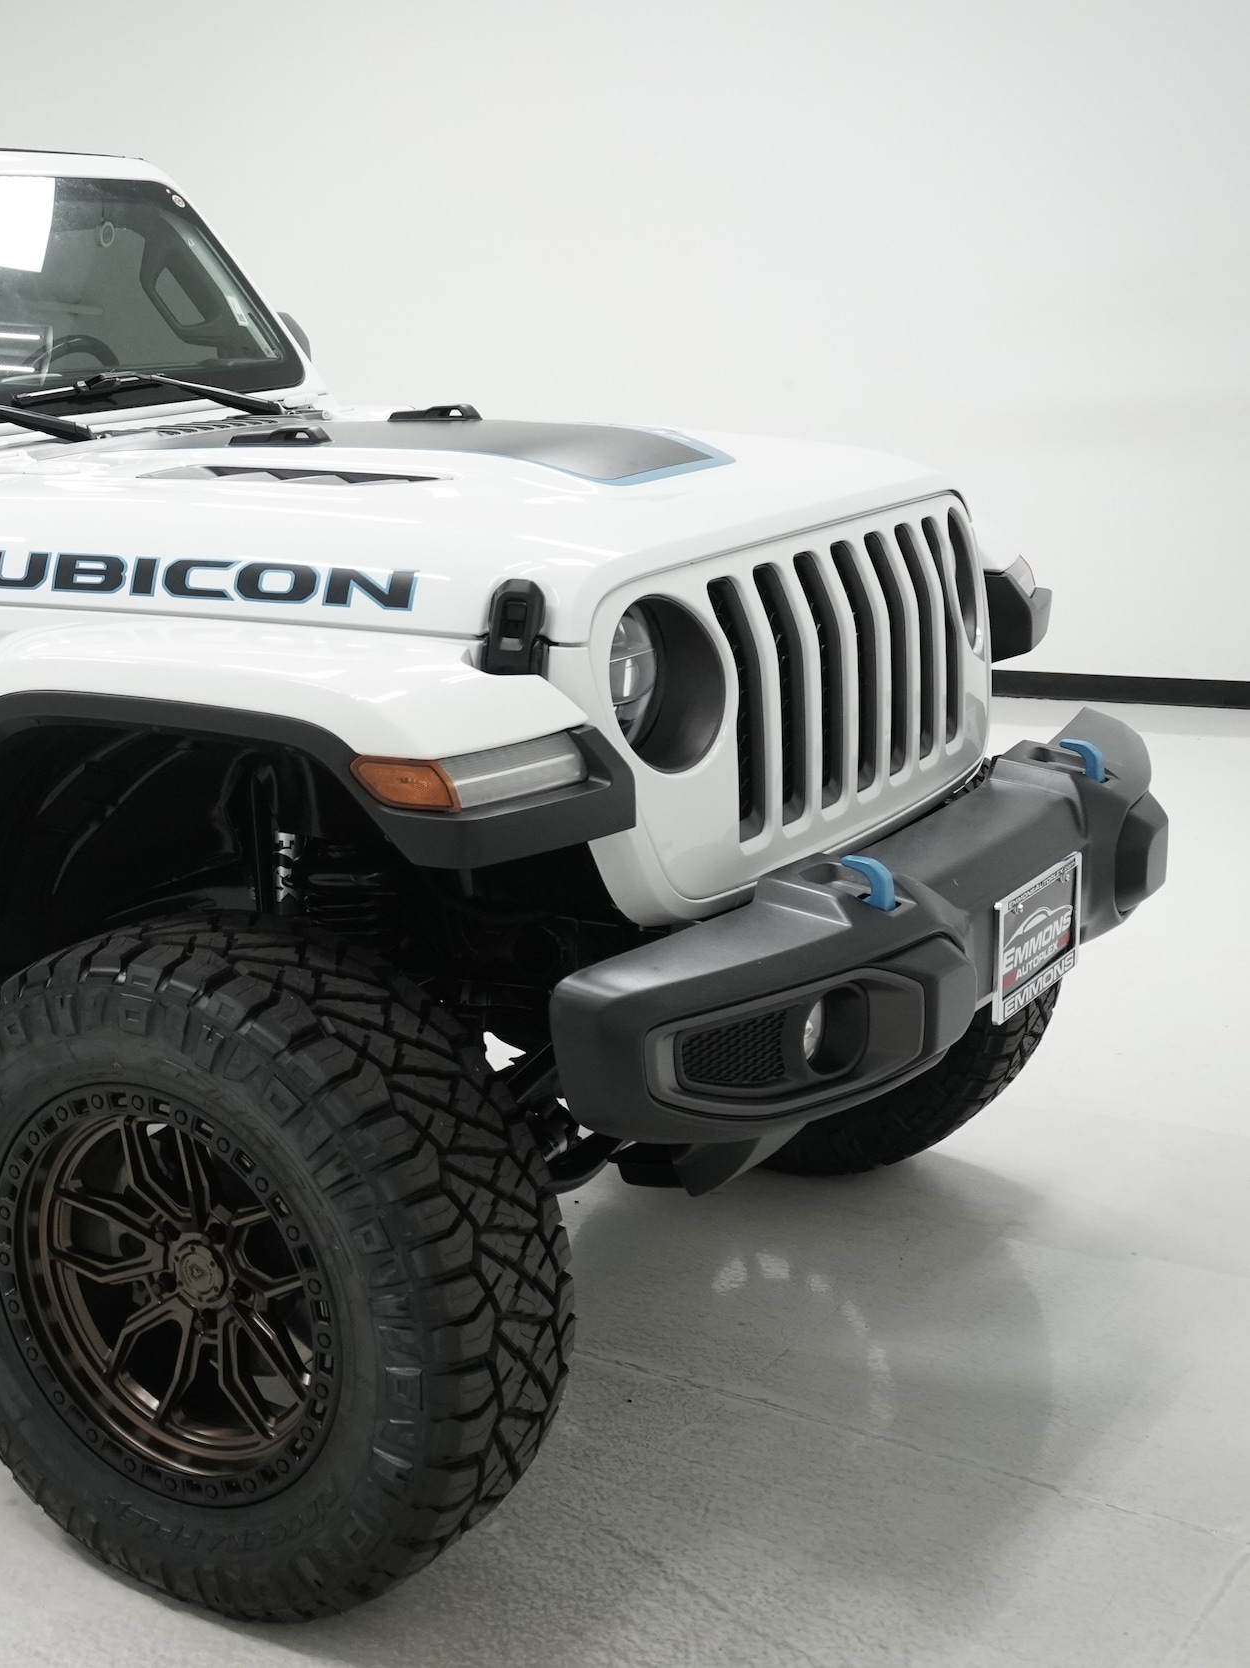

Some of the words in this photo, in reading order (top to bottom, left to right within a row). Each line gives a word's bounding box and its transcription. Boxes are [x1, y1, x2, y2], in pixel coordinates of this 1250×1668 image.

[1003, 911, 1073, 974] EMMONS
[1015, 939, 1059, 981] AUTOPLEX
[1004, 953, 1075, 1016] EMMONS
